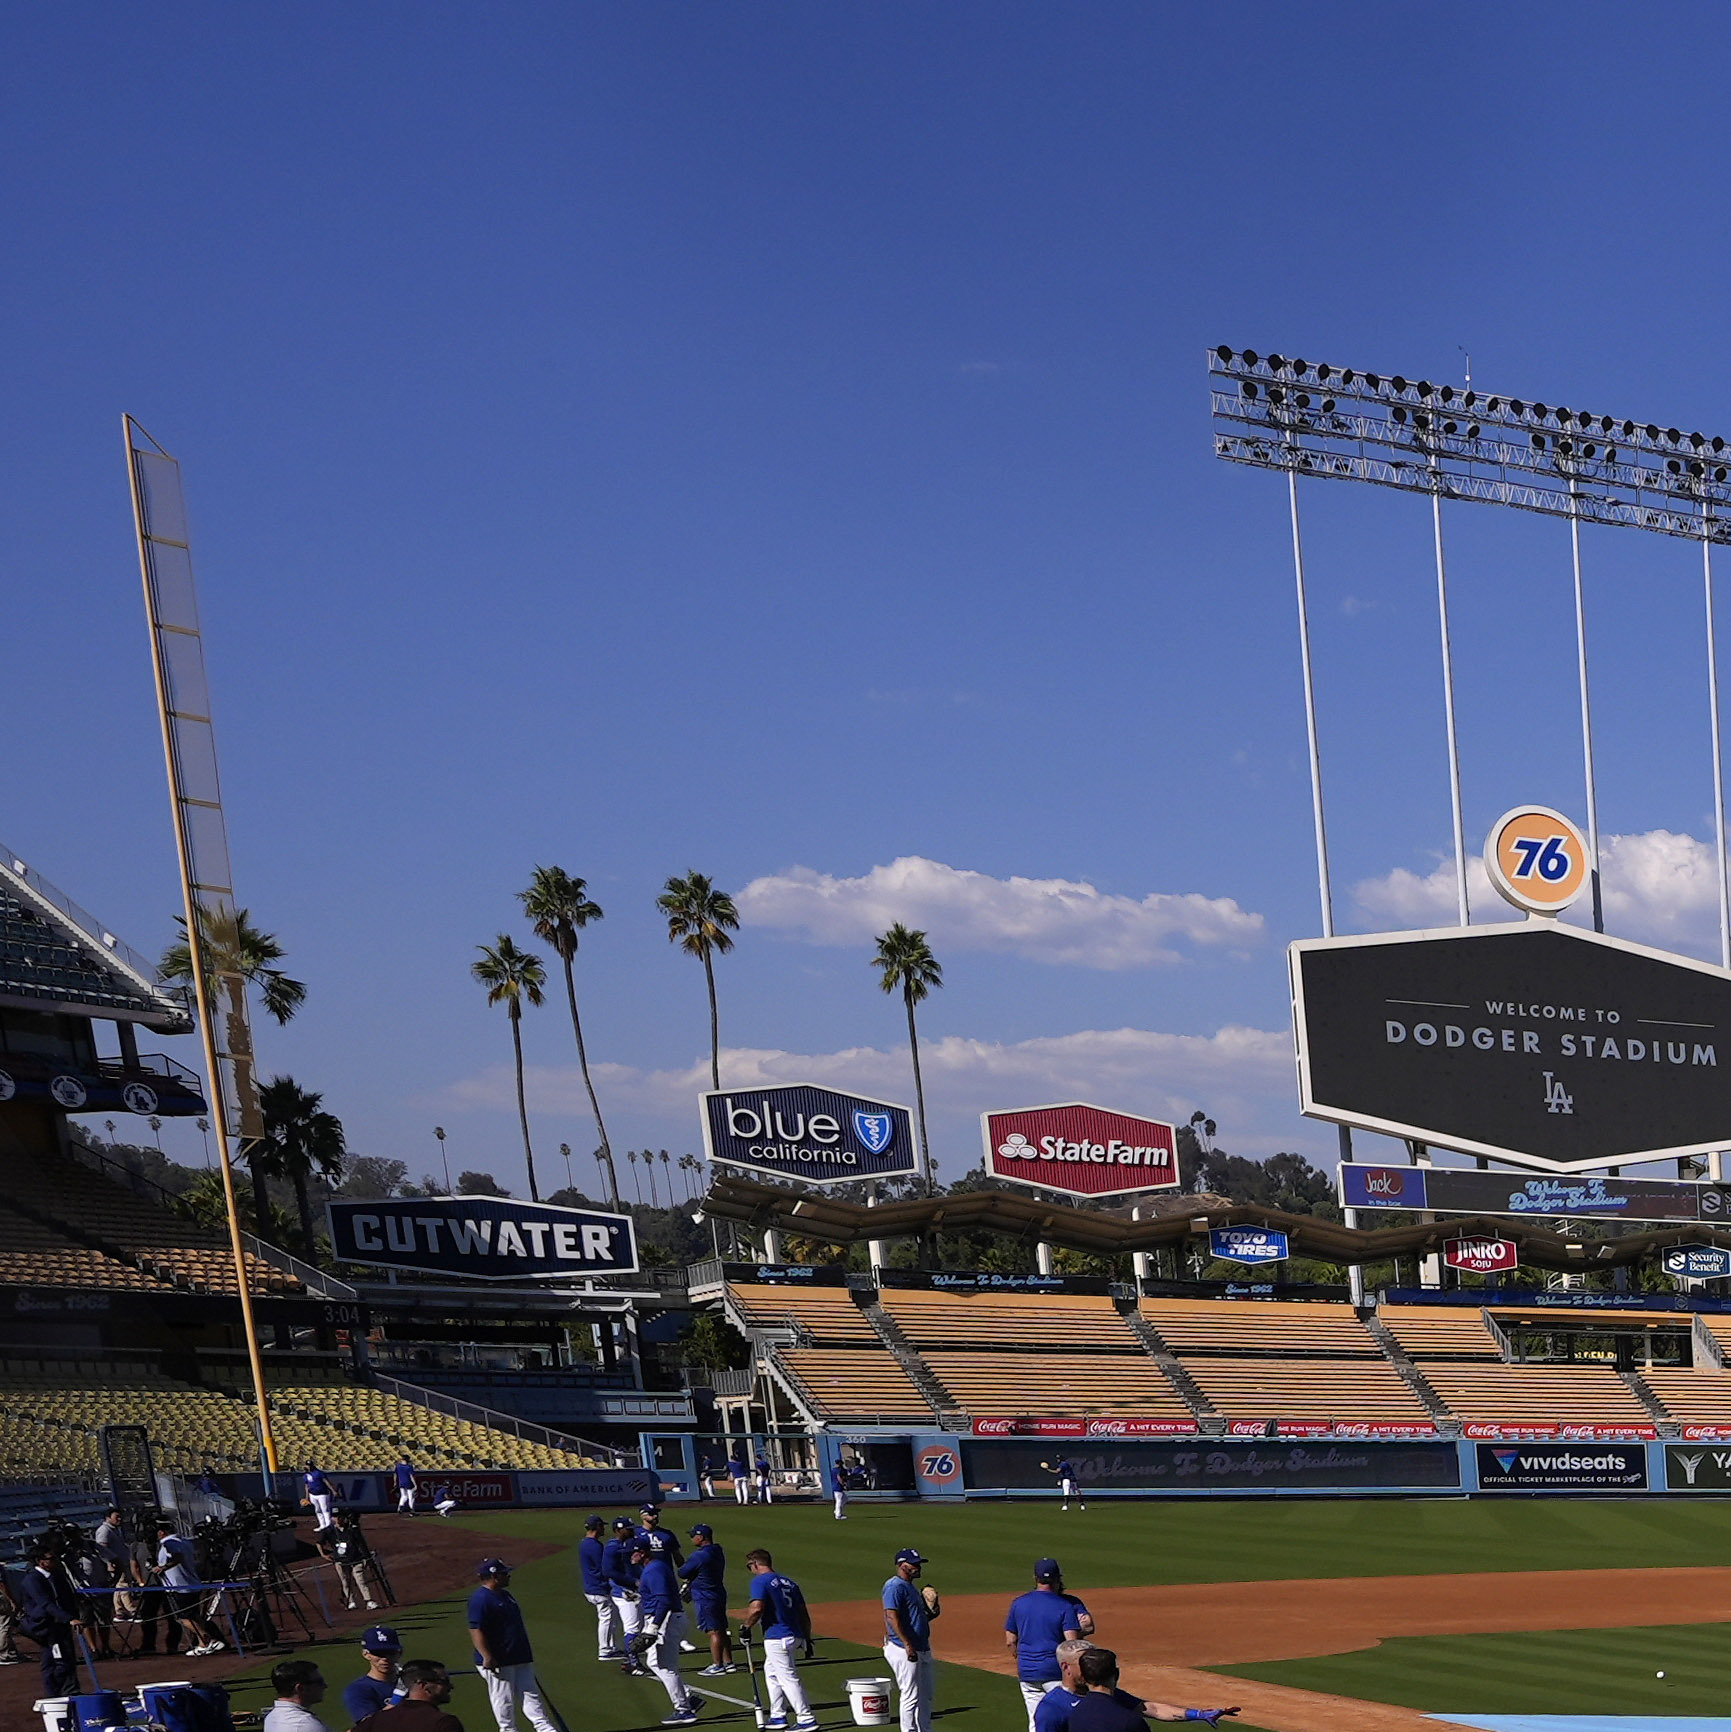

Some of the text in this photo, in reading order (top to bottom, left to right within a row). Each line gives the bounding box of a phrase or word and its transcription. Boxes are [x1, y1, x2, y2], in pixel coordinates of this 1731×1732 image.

[1510, 835, 1570, 883] 76
[1485, 1000, 1620, 1024] WELCOME TO
[1386, 1020, 1718, 1067] DODGER STADIUM
[726, 1098, 841, 1143] blue
[748, 1142, 857, 1166] california
[1365, 1171, 1402, 1195] Jack
[1525, 1179, 1606, 1197] Welcome To
[1566, 1190, 1628, 1209] Stadium
[351, 1213, 615, 1261] CUTWATER
[1219, 1231, 1267, 1245] TOYO
[1228, 1243, 1279, 1257] TIRES
[1456, 1240, 1506, 1263] JINRO
[1688, 1252, 1725, 1266] Security
[1689, 1262, 1724, 1273] Benefit
[325, 1304, 361, 1324] 3:04
[1090, 1420, 1127, 1433] Coca-Cola
[845, 1435, 867, 1444] 360
[922, 1453, 956, 1477] 76
[1520, 1452, 1626, 1470] vividseats
[420, 1478, 502, 1498] SteFarm
[522, 1483, 624, 1496] BANK OF AMERICA
